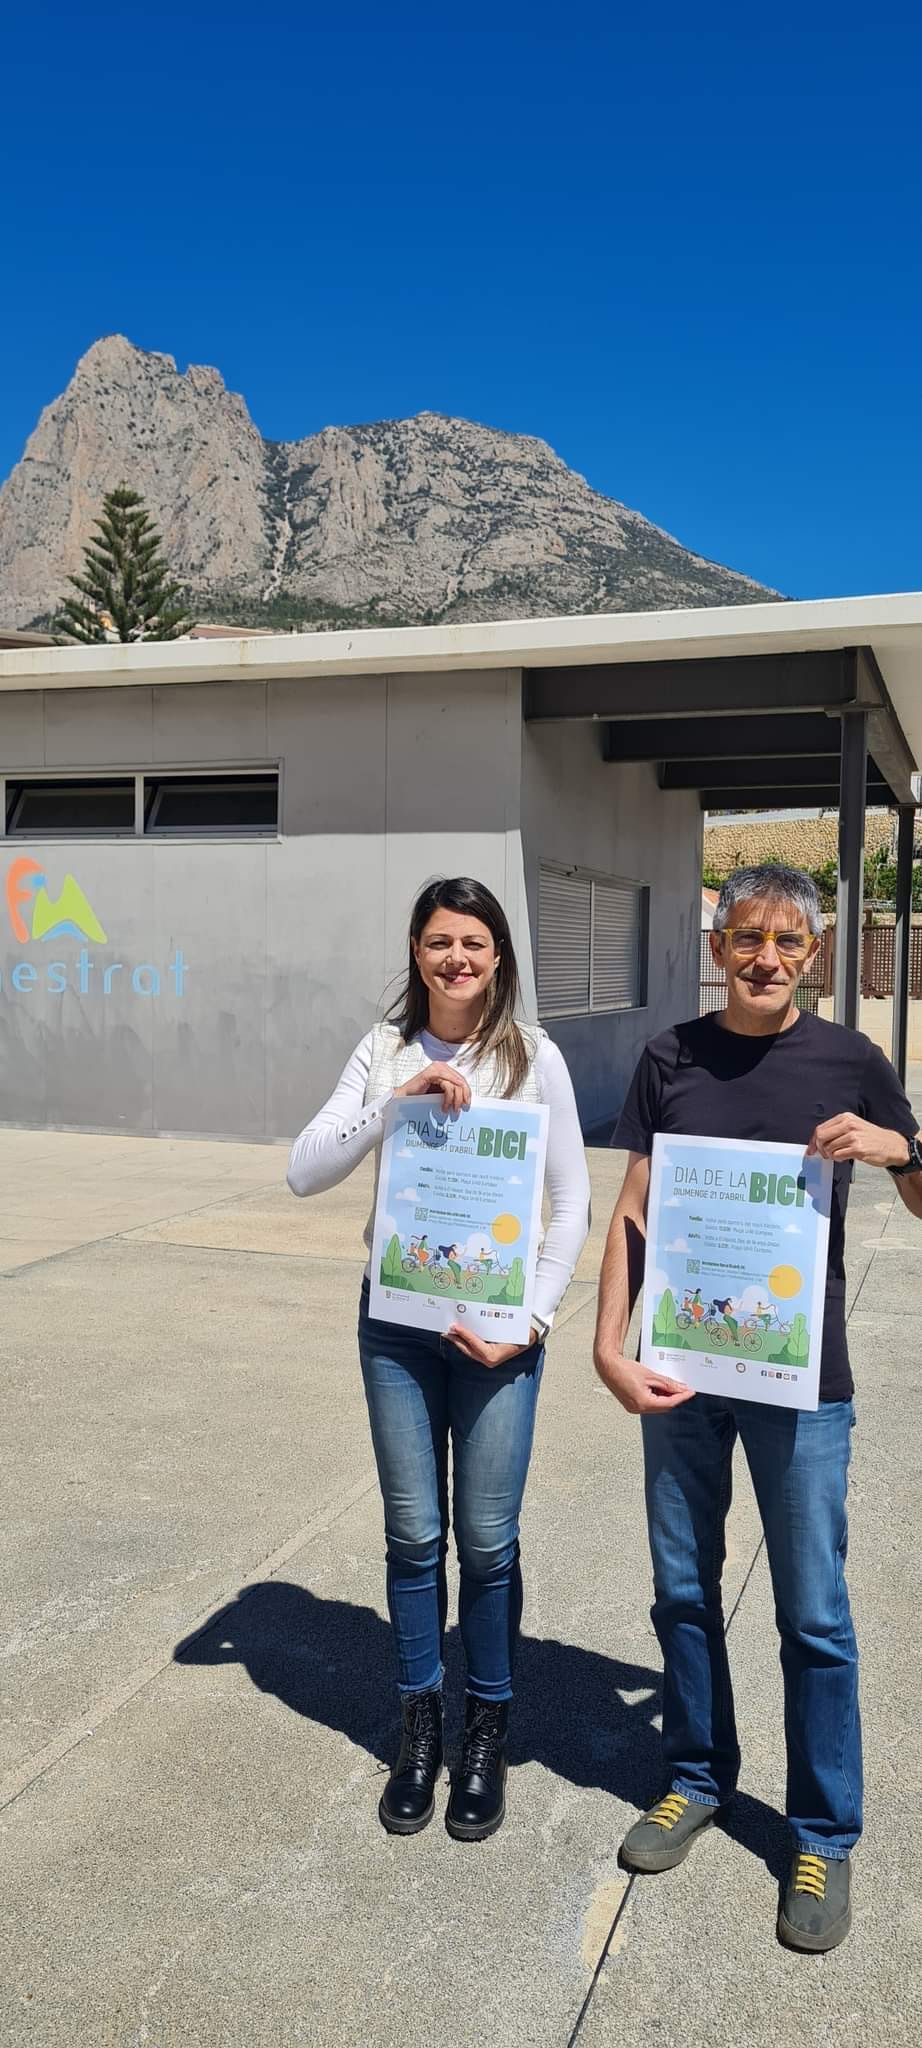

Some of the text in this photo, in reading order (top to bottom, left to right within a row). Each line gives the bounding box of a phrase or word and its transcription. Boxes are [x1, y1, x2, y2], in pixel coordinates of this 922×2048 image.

[0, 948, 189, 997] estrat
[405, 1139, 475, 1156] DIUMENGE 21 D'ABRIL
[407, 1120, 527, 1160] DIA DE LA BICI
[673, 1187, 745, 1201] DIUMENGE 21 D'ABRIL
[674, 1166, 806, 1207] DIA DE LA BICI
